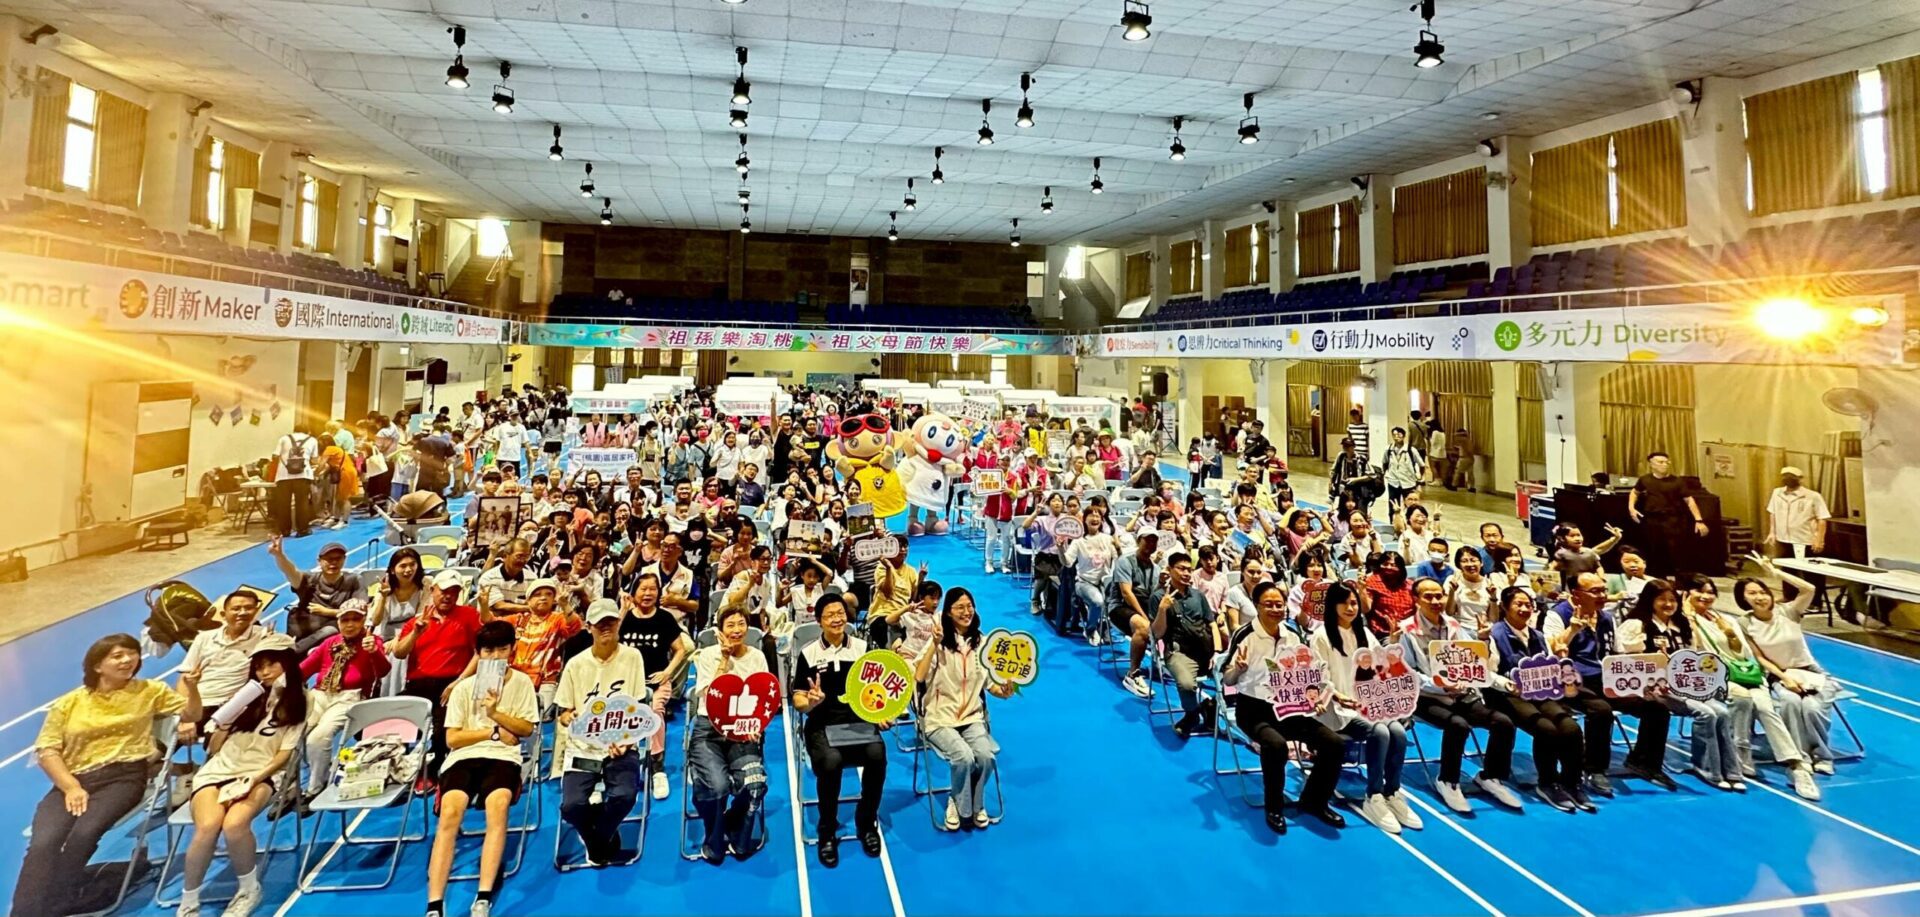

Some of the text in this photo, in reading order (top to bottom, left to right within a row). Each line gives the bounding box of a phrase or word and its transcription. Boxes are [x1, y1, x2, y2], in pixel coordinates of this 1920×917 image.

[151, 284, 261, 321] 創新 Maker
[295, 301, 394, 329] 國際 International
[667, 329, 971, 351] 祖孫樂淘桃 祖父母節快樂
[1213, 336, 1241, 349] Critical
[1243, 334, 1283, 351] Thinking
[1331, 328, 1434, 351] 行動力 Mobility
[1525, 319, 1728, 347] 多元力 Diversity
[1611, 661, 1656, 674] 祖父母節
[1681, 658, 1697, 673] 金
[1269, 668, 1321, 687] 祖父母節
[1278, 687, 1304, 703] 快樂
[1368, 696, 1412, 718] 我愛你
[721, 718, 761, 735] 一級棒
